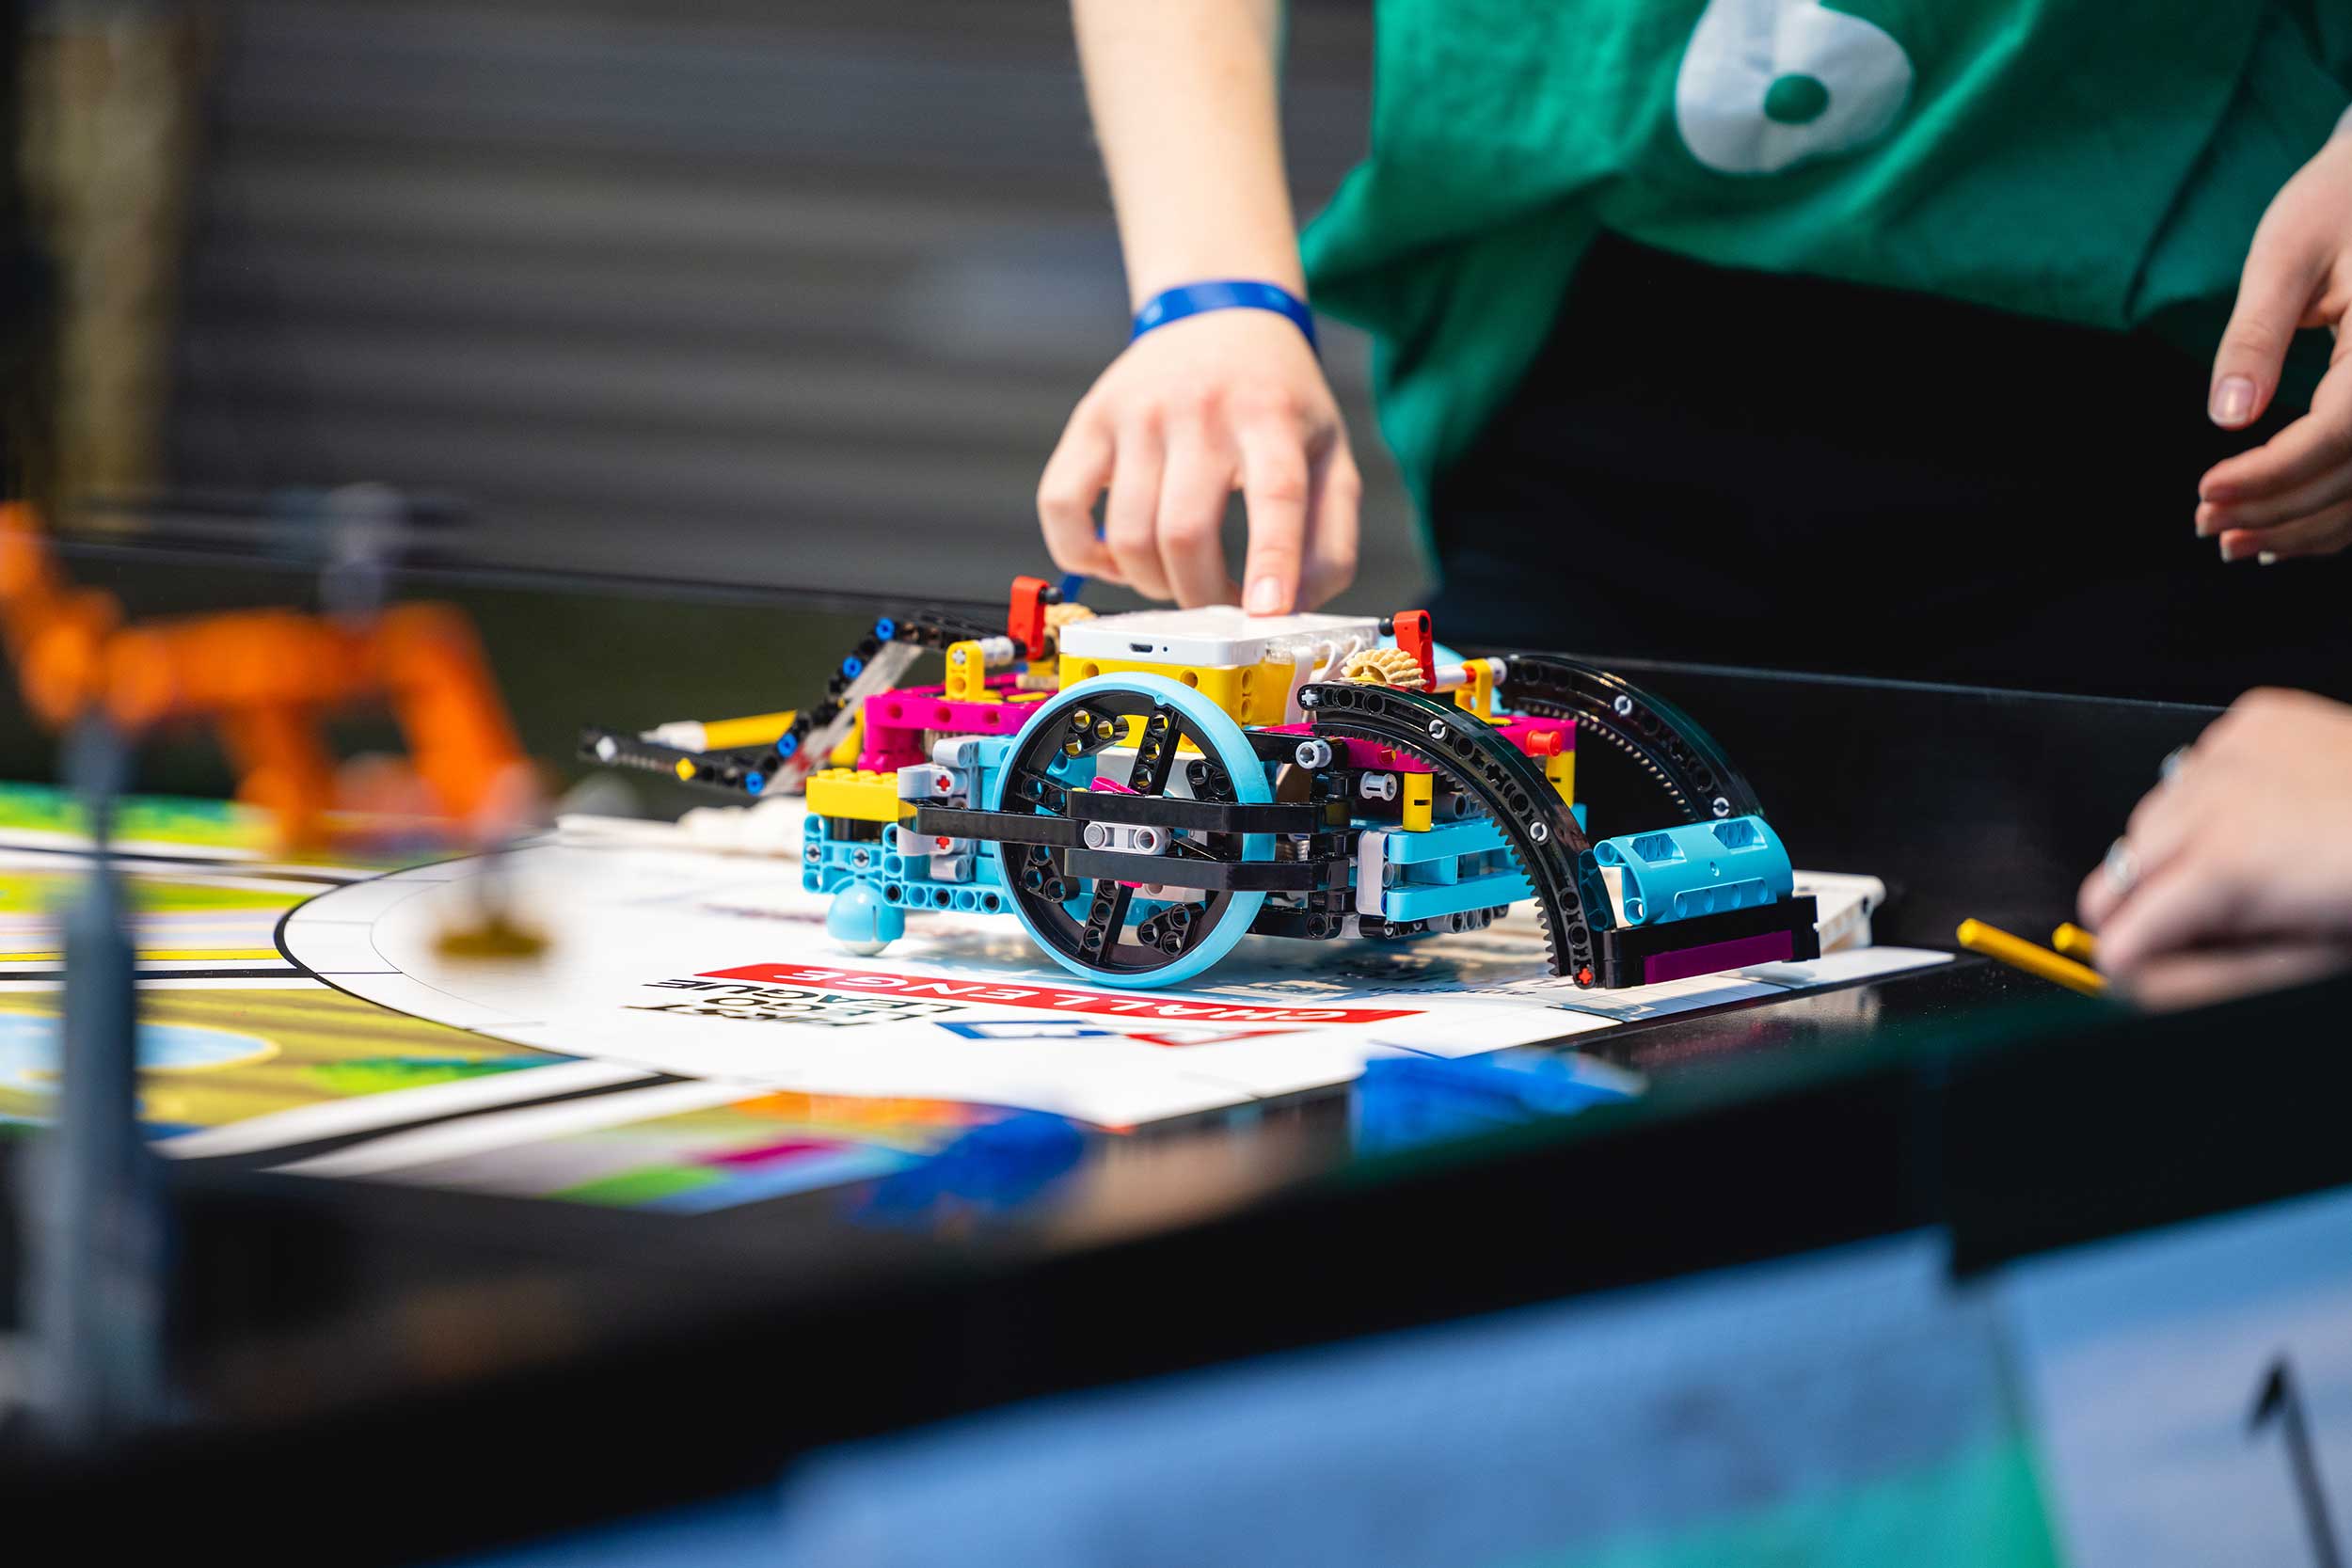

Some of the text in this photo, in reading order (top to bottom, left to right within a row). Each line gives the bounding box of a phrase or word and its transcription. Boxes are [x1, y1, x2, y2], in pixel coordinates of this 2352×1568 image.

[642, 979, 968, 1013] LEAGUE
[704, 997, 924, 1022] LEGO
[773, 970, 1349, 1021] CHALLENGE
